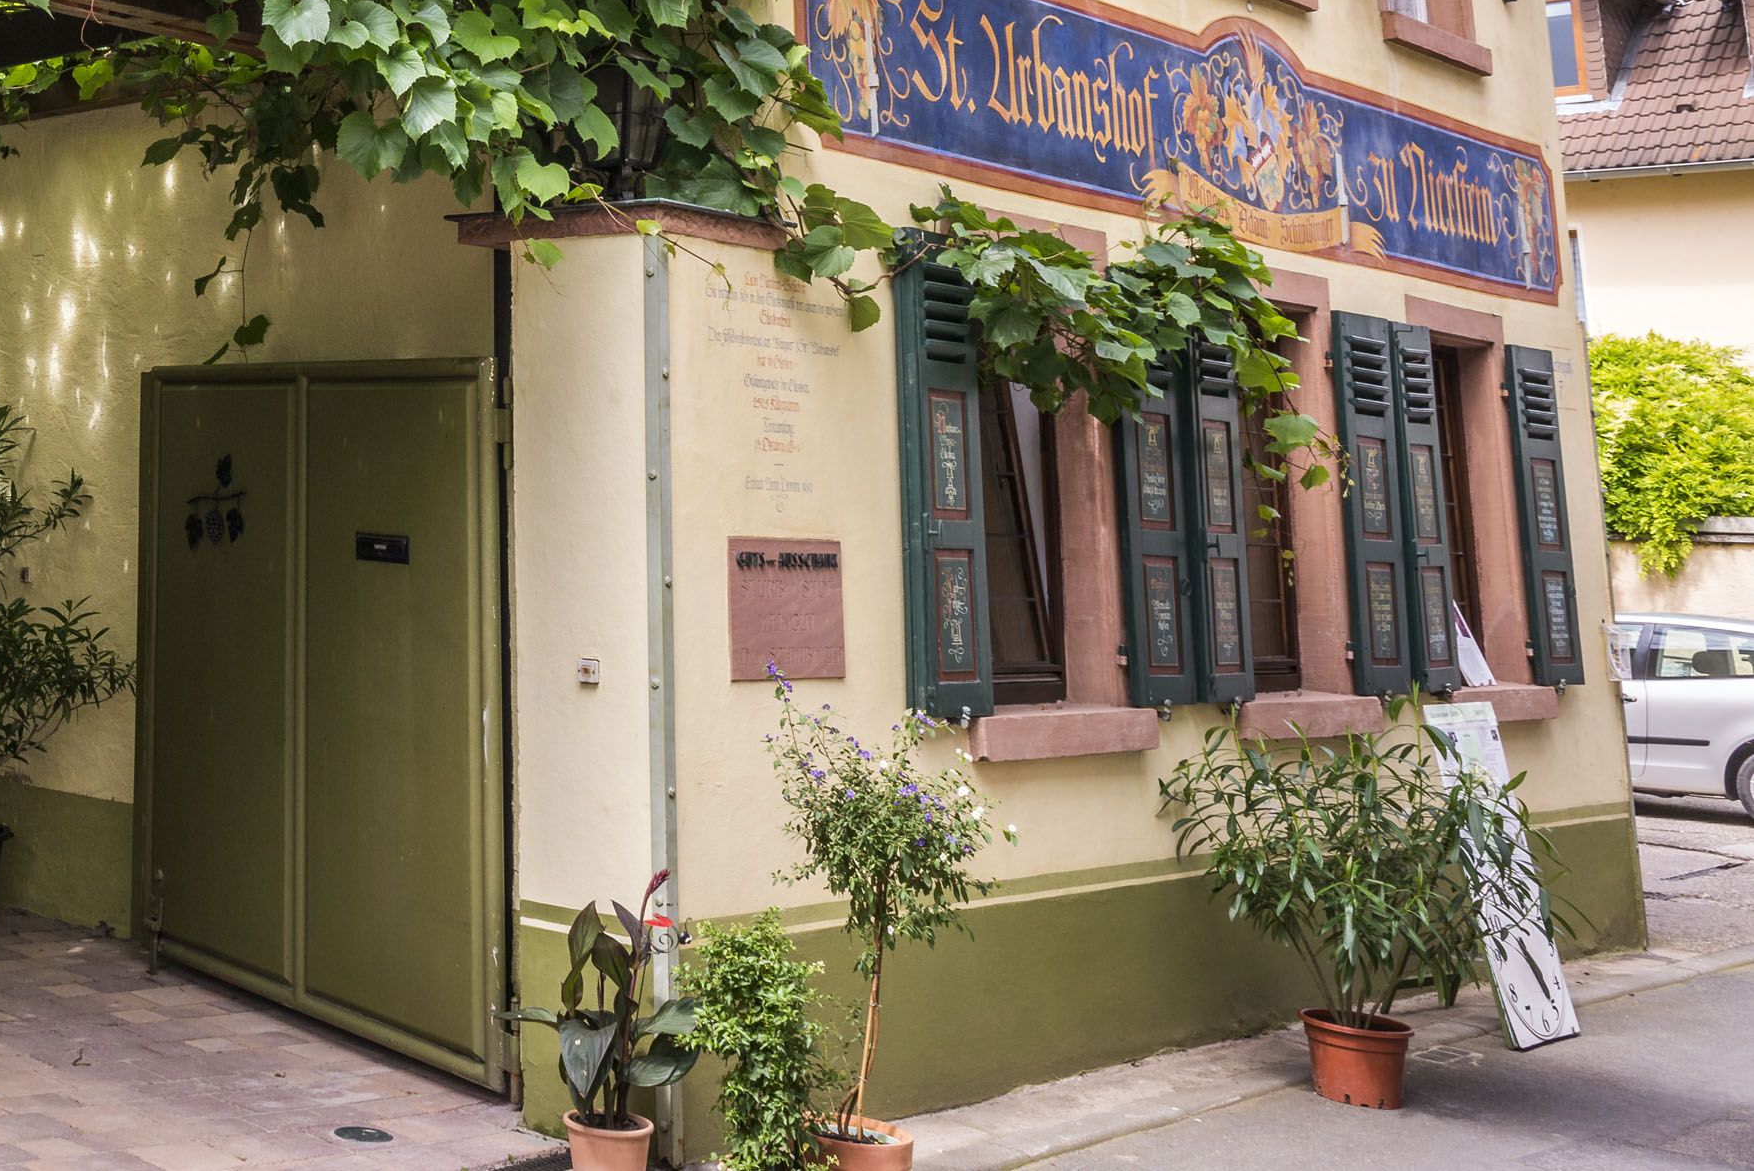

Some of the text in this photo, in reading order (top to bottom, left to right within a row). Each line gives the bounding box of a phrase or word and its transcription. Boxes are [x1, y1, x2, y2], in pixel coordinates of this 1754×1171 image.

[980, 14, 1160, 170] Urbanshof
[1399, 142, 1500, 248] Nierstein
[1509, 983, 1518, 1003] 8
[1542, 1008, 1550, 1033] 6
